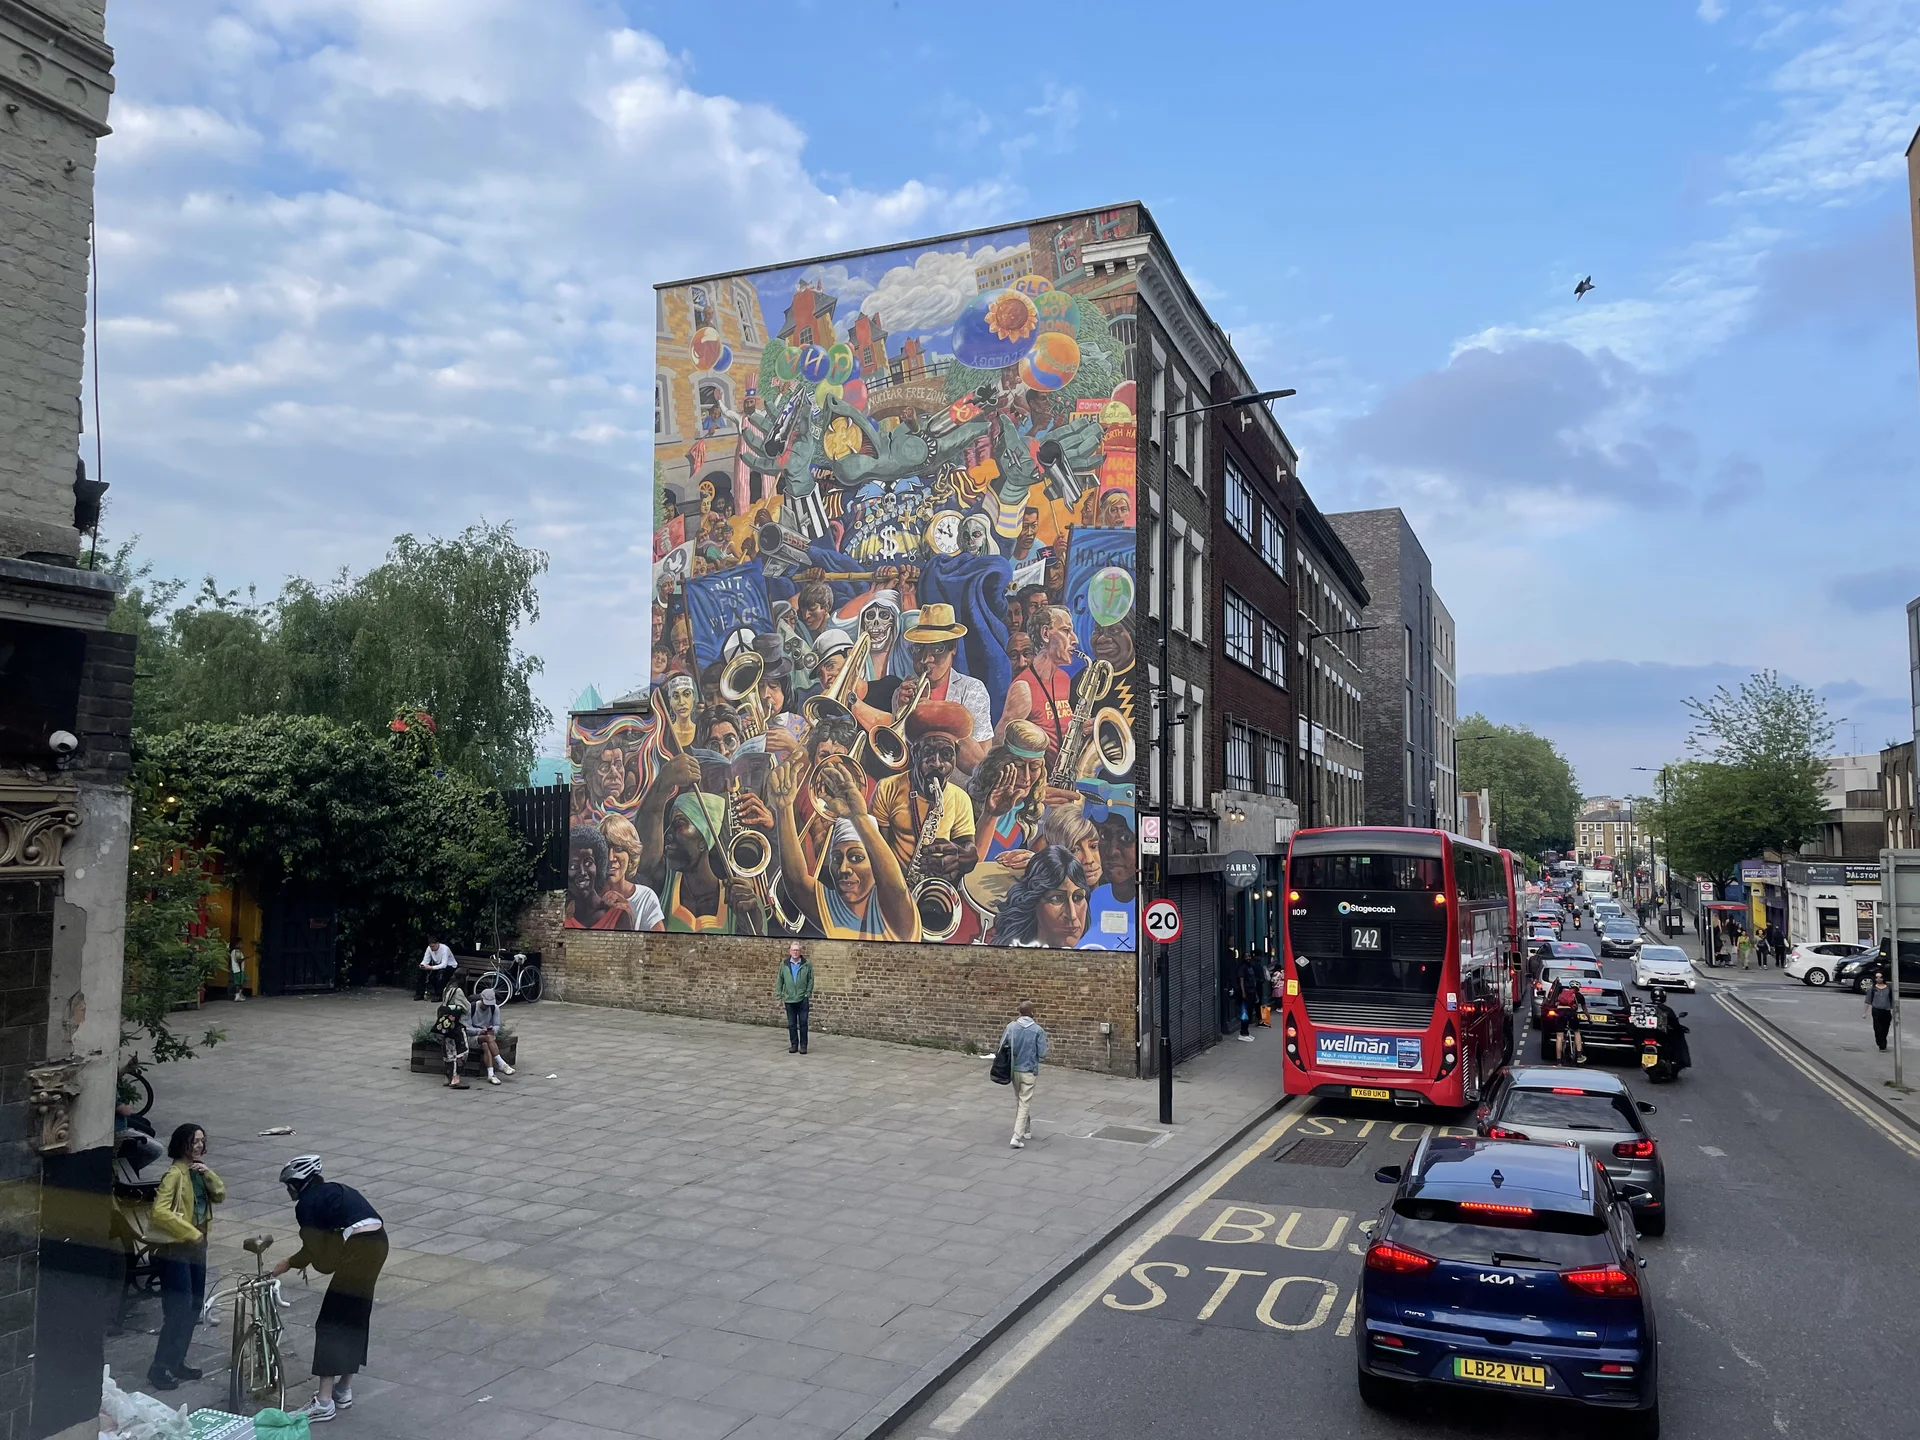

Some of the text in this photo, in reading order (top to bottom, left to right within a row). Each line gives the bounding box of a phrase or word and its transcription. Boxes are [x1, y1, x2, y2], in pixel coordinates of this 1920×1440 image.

[1016, 280, 1049, 296] GLC
[868, 387, 949, 405] NUCLEAR FREE ZONE
[1102, 428, 1124, 442] NORTH
[719, 592, 748, 612] FOR
[1225, 863, 1257, 872] FARR'S
[1845, 871, 1879, 880] DALSTON
[1292, 908, 1307, 916] 11019
[1350, 904, 1396, 914] Stagecoach
[1148, 911, 1178, 930] 20
[1354, 928, 1378, 948] 242
[1320, 1034, 1390, 1055] wellman
[1479, 1273, 1514, 1285] KIA
[1101, 1261, 1357, 1337] STO
[1464, 1360, 1506, 1380] LB22
[1510, 1366, 1543, 1384] VLL
